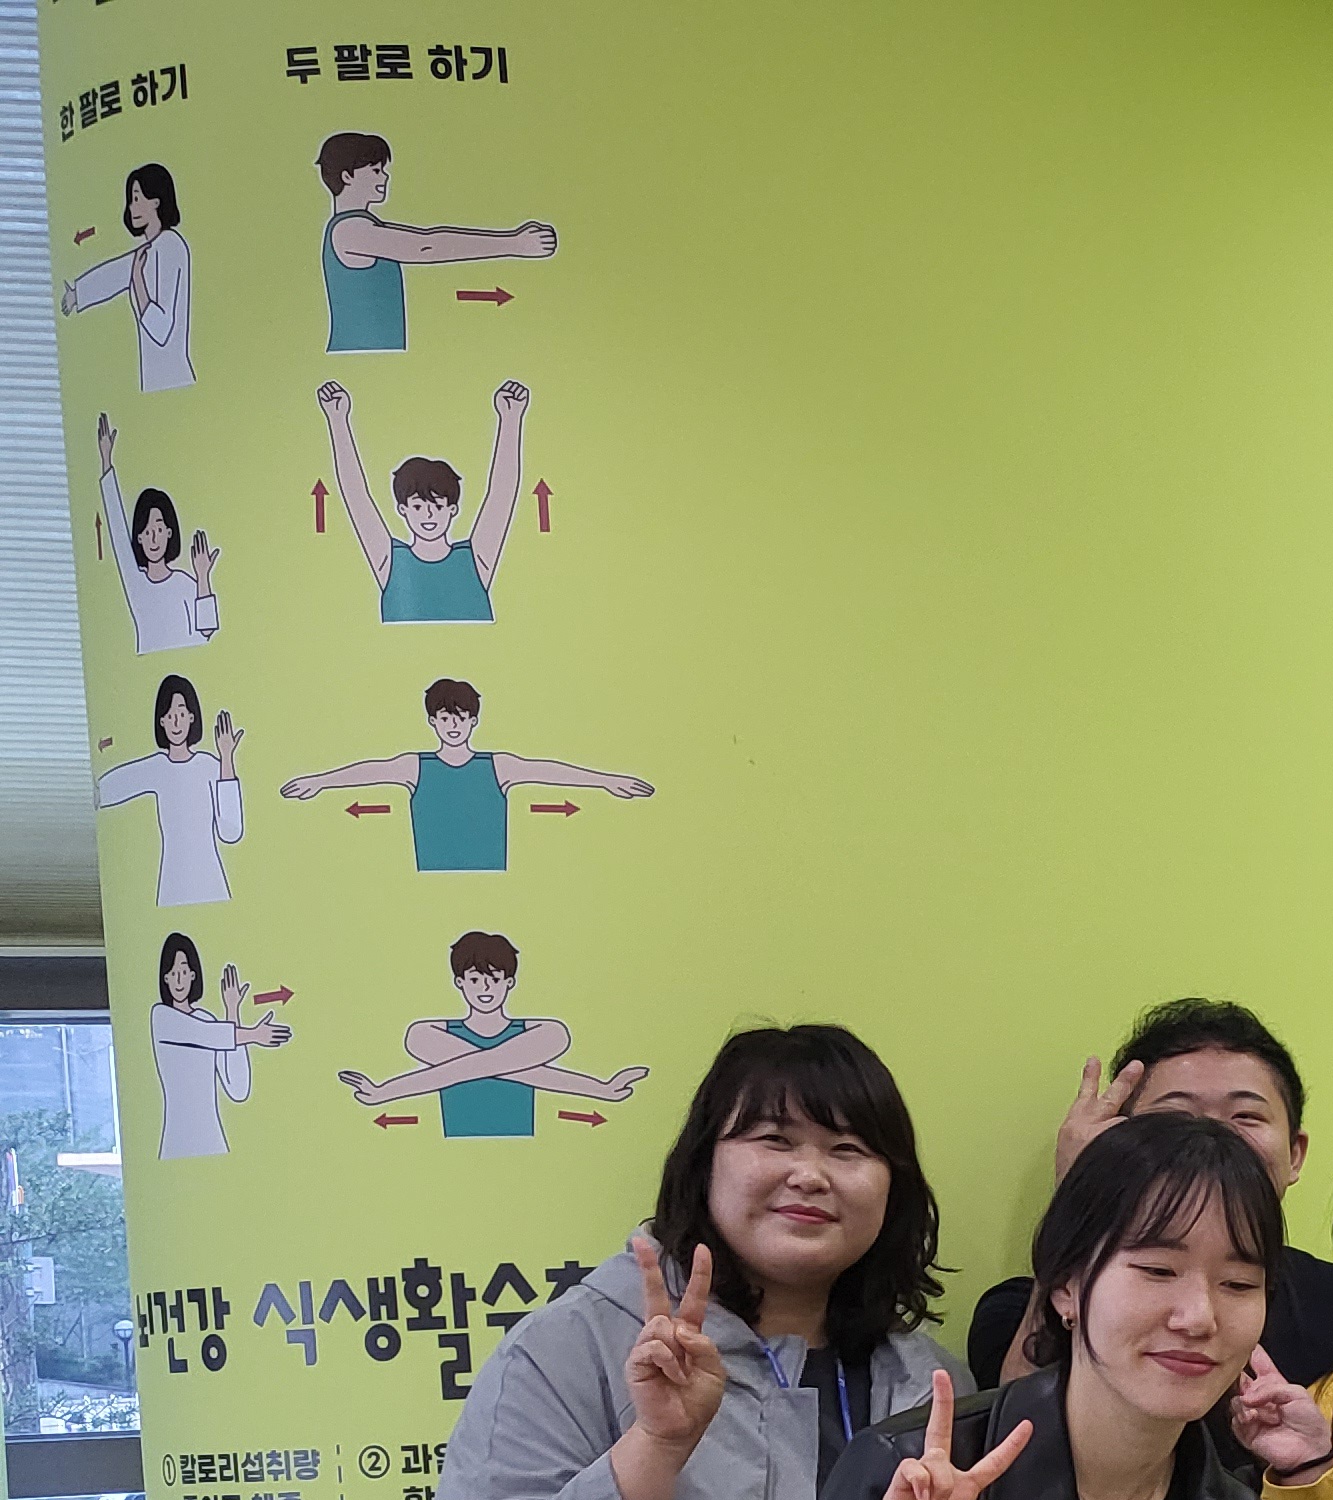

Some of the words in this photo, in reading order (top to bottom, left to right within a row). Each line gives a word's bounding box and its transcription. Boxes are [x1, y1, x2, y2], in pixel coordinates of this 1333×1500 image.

[285, 46, 321, 84] 두
[334, 43, 413, 82] 팔로
[427, 44, 511, 84] 하기
[60, 100, 75, 143] 한
[79, 80, 122, 129] 팔로
[131, 63, 188, 107] 하기
[253, 1257, 598, 1401] 식생활수
[179, 1449, 320, 1485] 칼로리섭취량
